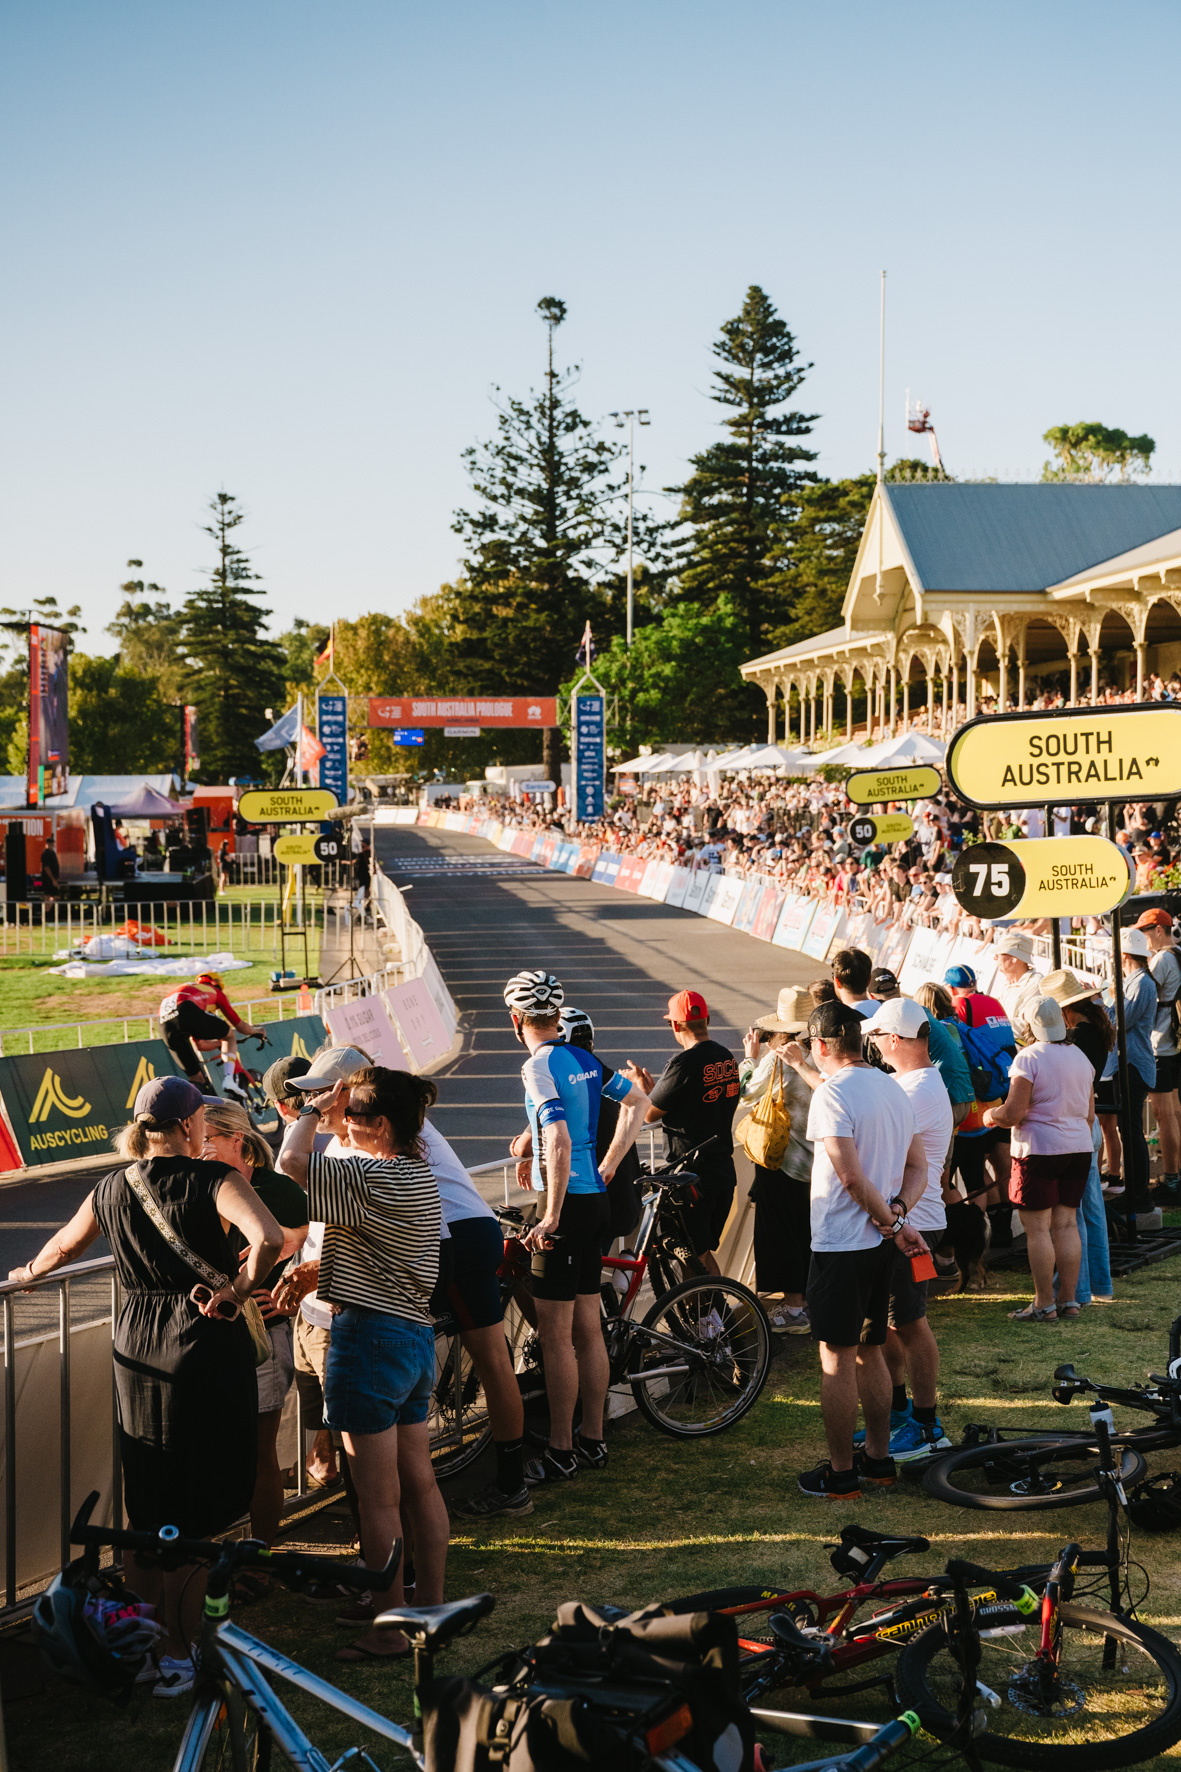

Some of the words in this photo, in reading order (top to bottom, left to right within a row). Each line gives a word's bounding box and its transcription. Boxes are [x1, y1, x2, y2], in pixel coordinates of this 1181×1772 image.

[411, 701, 437, 717] SOUTH
[437, 701, 475, 717] AUSTRALIA
[475, 701, 514, 717] PROLOGUE
[1028, 730, 1113, 758] SOUTH
[1001, 757, 1144, 787] AUSTRALIA
[876, 775, 908, 787] SOUTH
[866, 784, 919, 798] AUSTRALIA
[270, 796, 303, 806] SOUTH
[259, 806, 314, 816] AUSTRALIA
[855, 824, 873, 839] 50
[320, 841, 338, 856] 50
[1051, 863, 1094, 877] SOUTH
[969, 863, 1010, 897] 75
[1038, 876, 1109, 891] AUSTRALIA
[30, 1124, 109, 1151] AUSCYCLING
